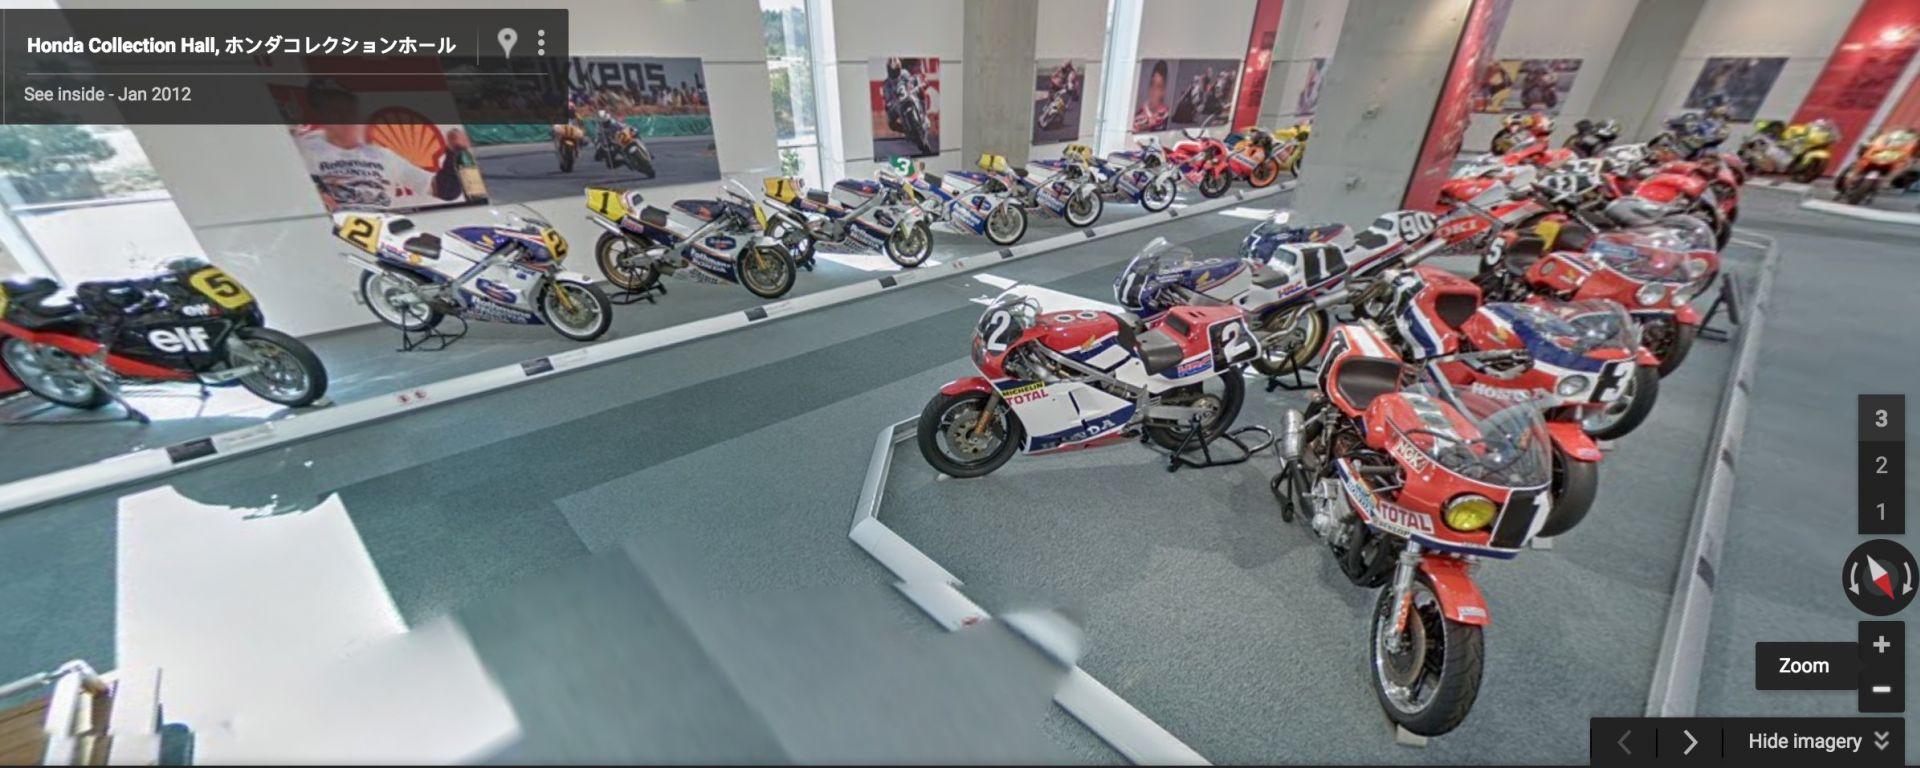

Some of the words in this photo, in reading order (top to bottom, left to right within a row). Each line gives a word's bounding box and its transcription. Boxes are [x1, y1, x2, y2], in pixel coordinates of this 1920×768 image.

[894, 157, 911, 176] 3
[600, 192, 610, 215] 1
[774, 180, 784, 198] 1
[347, 218, 374, 249] 2
[1400, 212, 1433, 241] 90
[550, 230, 568, 257] 2
[1486, 237, 1505, 266] 5
[1317, 247, 1332, 279] 1
[205, 273, 240, 298] 5
[1121, 272, 1136, 304] 1
[149, 326, 212, 353] elf
[986, 309, 1012, 351] 2
[1221, 321, 1251, 363] 2
[1002, 382, 1044, 396] MICHELIN
[1600, 362, 1635, 402] 3
[1006, 389, 1049, 405] TOTAL
[1381, 503, 1431, 532] TOTAL
[1520, 490, 1551, 546] 1
